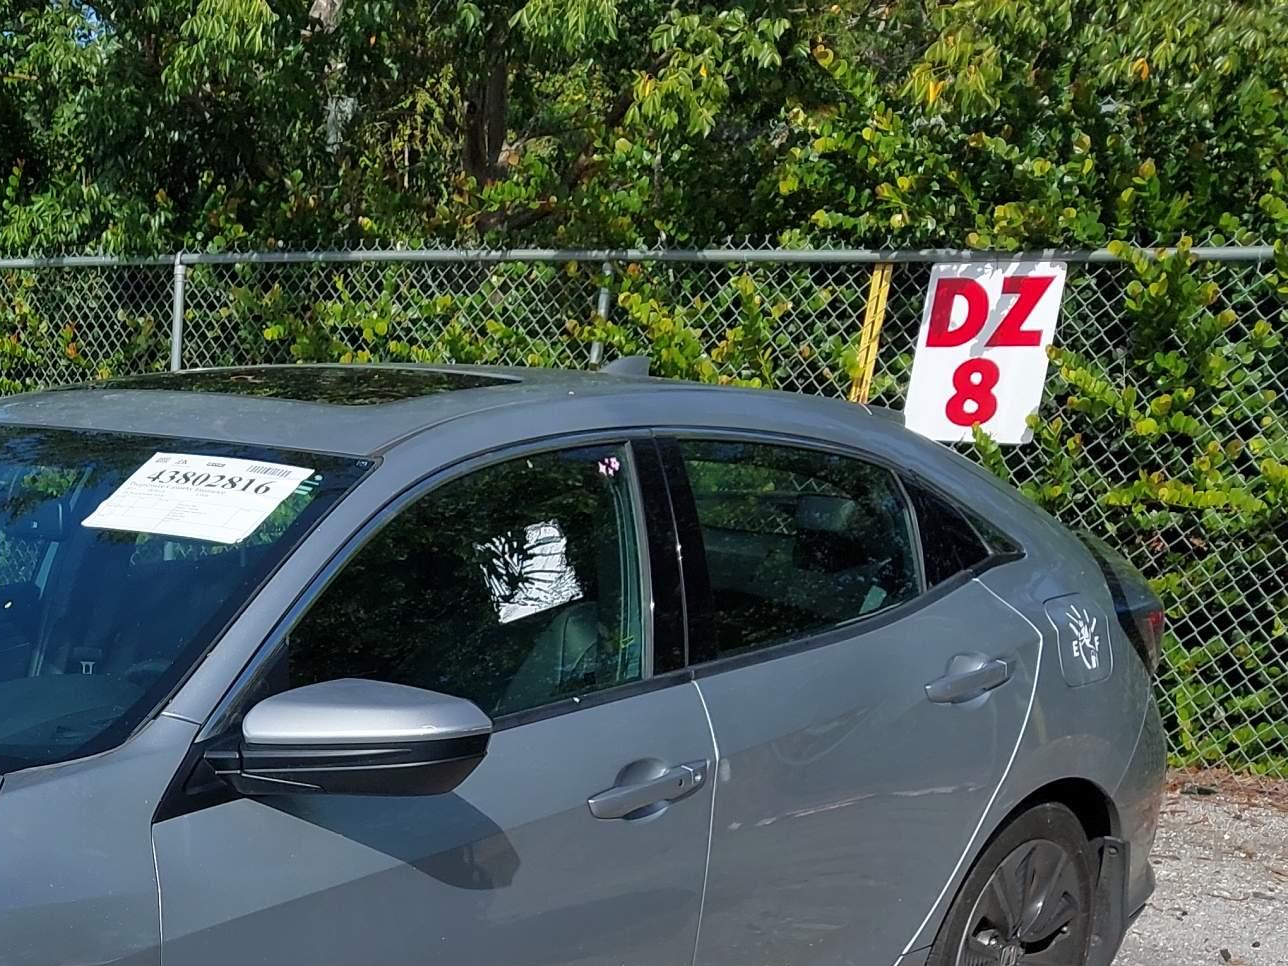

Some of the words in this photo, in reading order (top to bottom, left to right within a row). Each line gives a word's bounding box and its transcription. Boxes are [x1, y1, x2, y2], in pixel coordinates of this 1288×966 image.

[925, 275, 1057, 348] DZ
[945, 357, 1000, 427] 8
[146, 468, 279, 496] 43802816
[1072, 639, 1080, 657] E
[1094, 635, 1100, 652] F
